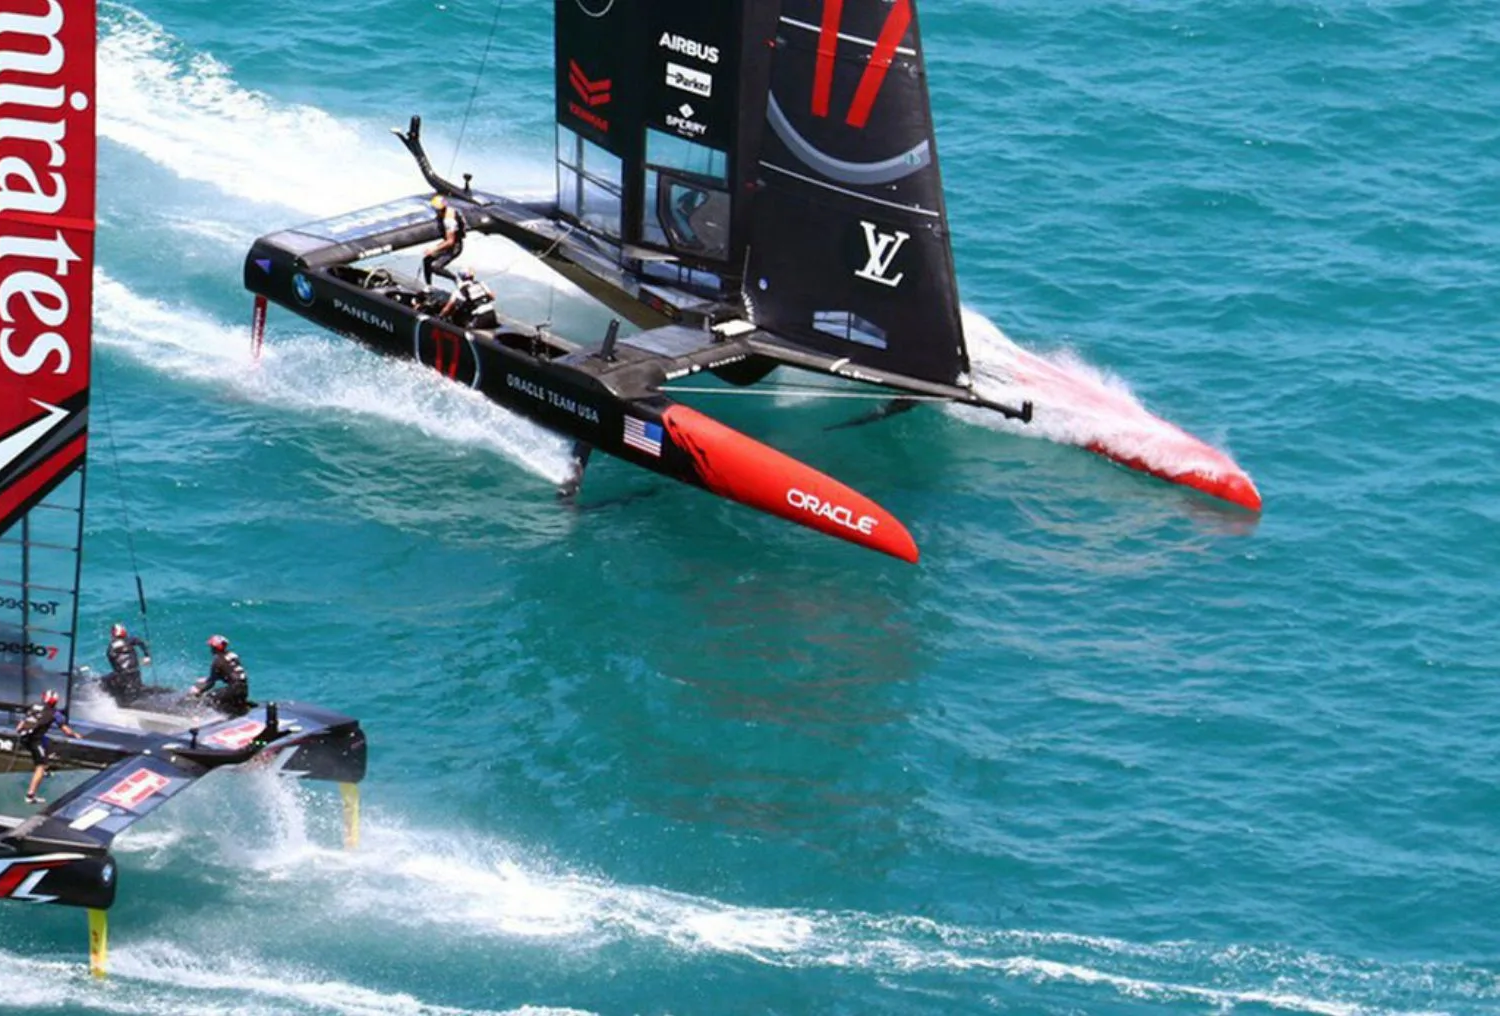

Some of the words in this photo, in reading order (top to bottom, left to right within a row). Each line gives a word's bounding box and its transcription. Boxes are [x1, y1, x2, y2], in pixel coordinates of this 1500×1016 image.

[658, 31, 720, 64] AIRBUS
[674, 72, 710, 92] Parker
[332, 298, 394, 333] PANERAI
[506, 373, 545, 400] ORACLE
[547, 390, 576, 413] TEAM
[577, 404, 600, 424] USA
[786, 488, 879, 536] ORACLE
